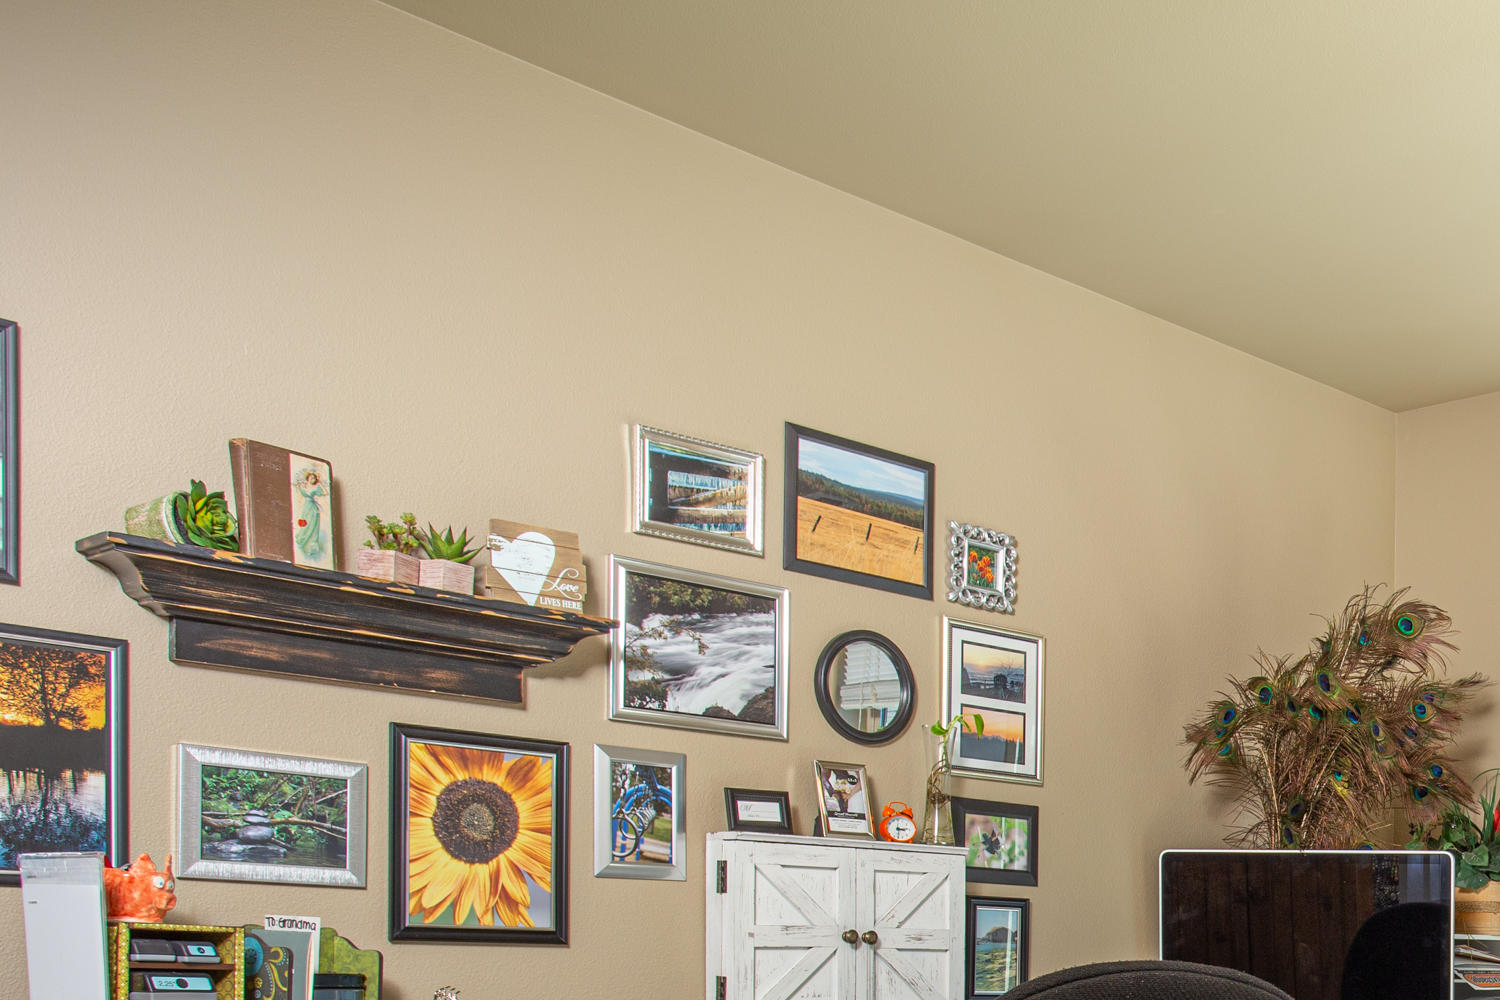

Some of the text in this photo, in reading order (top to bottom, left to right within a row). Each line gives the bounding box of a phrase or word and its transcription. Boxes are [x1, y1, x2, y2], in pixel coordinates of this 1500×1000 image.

[543, 567, 583, 600] Love
[540, 596, 582, 610] LIVES HERE
[278, 917, 317, 931] Grandma
